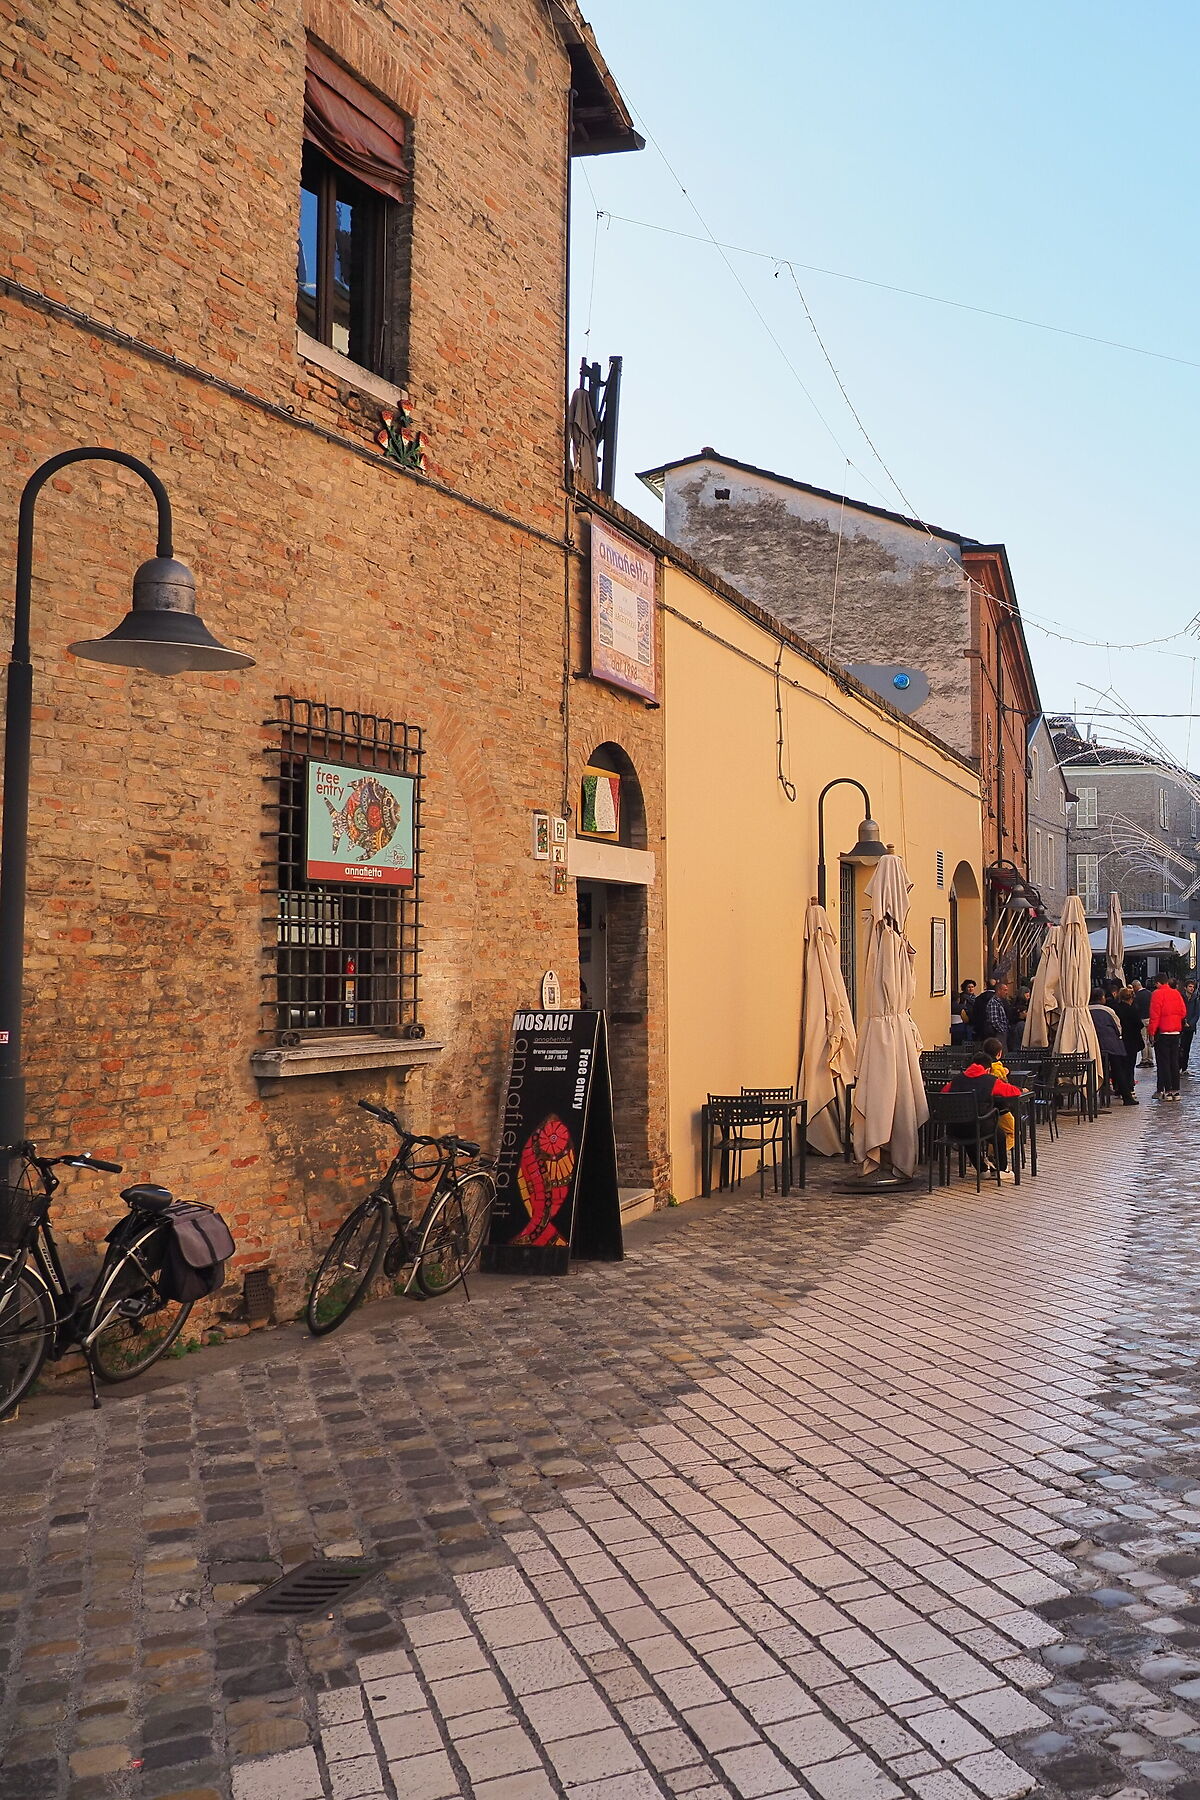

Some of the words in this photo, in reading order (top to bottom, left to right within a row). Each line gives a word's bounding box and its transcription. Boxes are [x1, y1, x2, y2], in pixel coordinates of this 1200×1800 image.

[599, 541, 649, 587] annafietta
[611, 658, 622, 672] dal
[316, 766, 340, 785] free
[316, 783, 345, 801] entry
[345, 866, 382, 878] annafietta
[512, 1014, 574, 1031] MOSAICI
[577, 1048, 591, 1075] Free
[572, 1077, 586, 1110] entry
